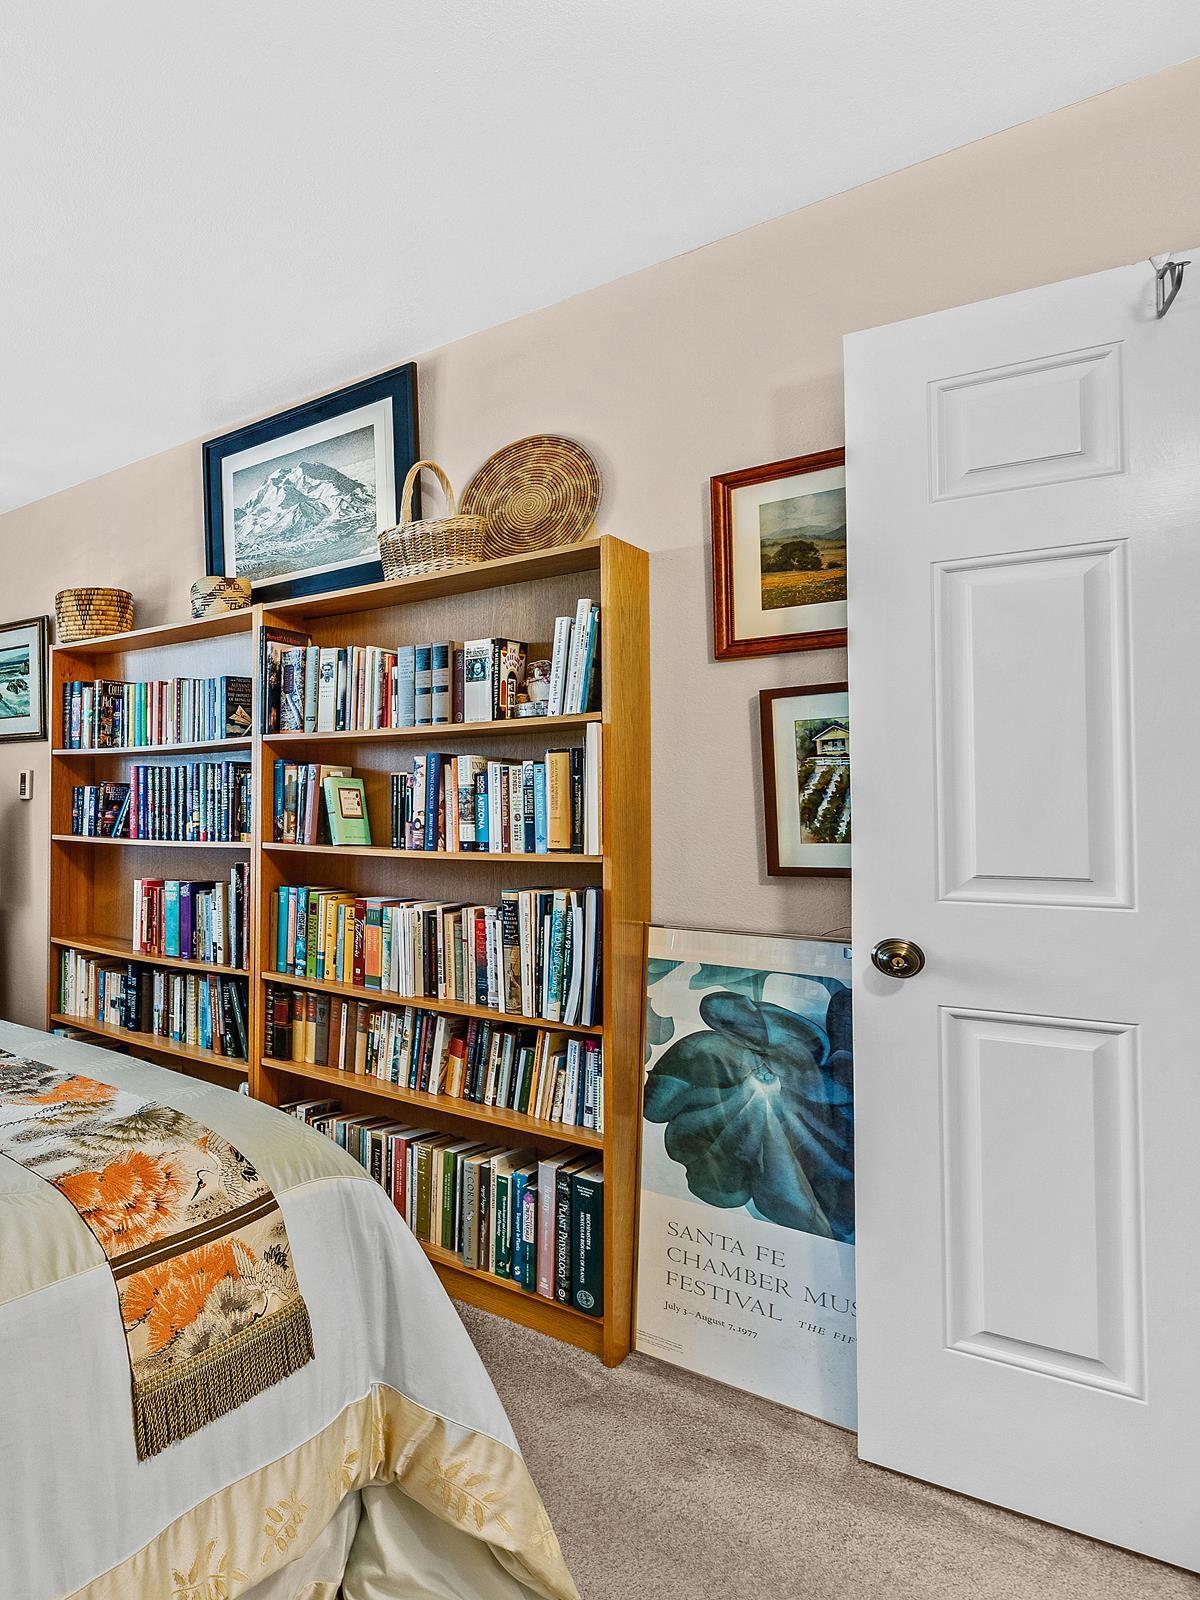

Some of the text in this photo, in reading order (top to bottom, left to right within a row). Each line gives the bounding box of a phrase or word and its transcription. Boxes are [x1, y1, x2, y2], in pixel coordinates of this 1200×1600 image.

[555, 909, 564, 930] BACK
[553, 931, 562, 956] ROADS
[565, 940, 572, 949] 99
[550, 964, 560, 994] California
[466, 1176, 474, 1206] CORN
[558, 1202, 568, 1280] PLANT PHYSIOLOGY
[667, 1221, 786, 1268] SANTA FE
[667, 1247, 792, 1298] CHAMBER
[666, 1271, 783, 1322] FESTIVAL
[664, 1301, 681, 1314] July
[738, 1327, 758, 1340] 1977
[798, 1320, 857, 1344] THE FIF
